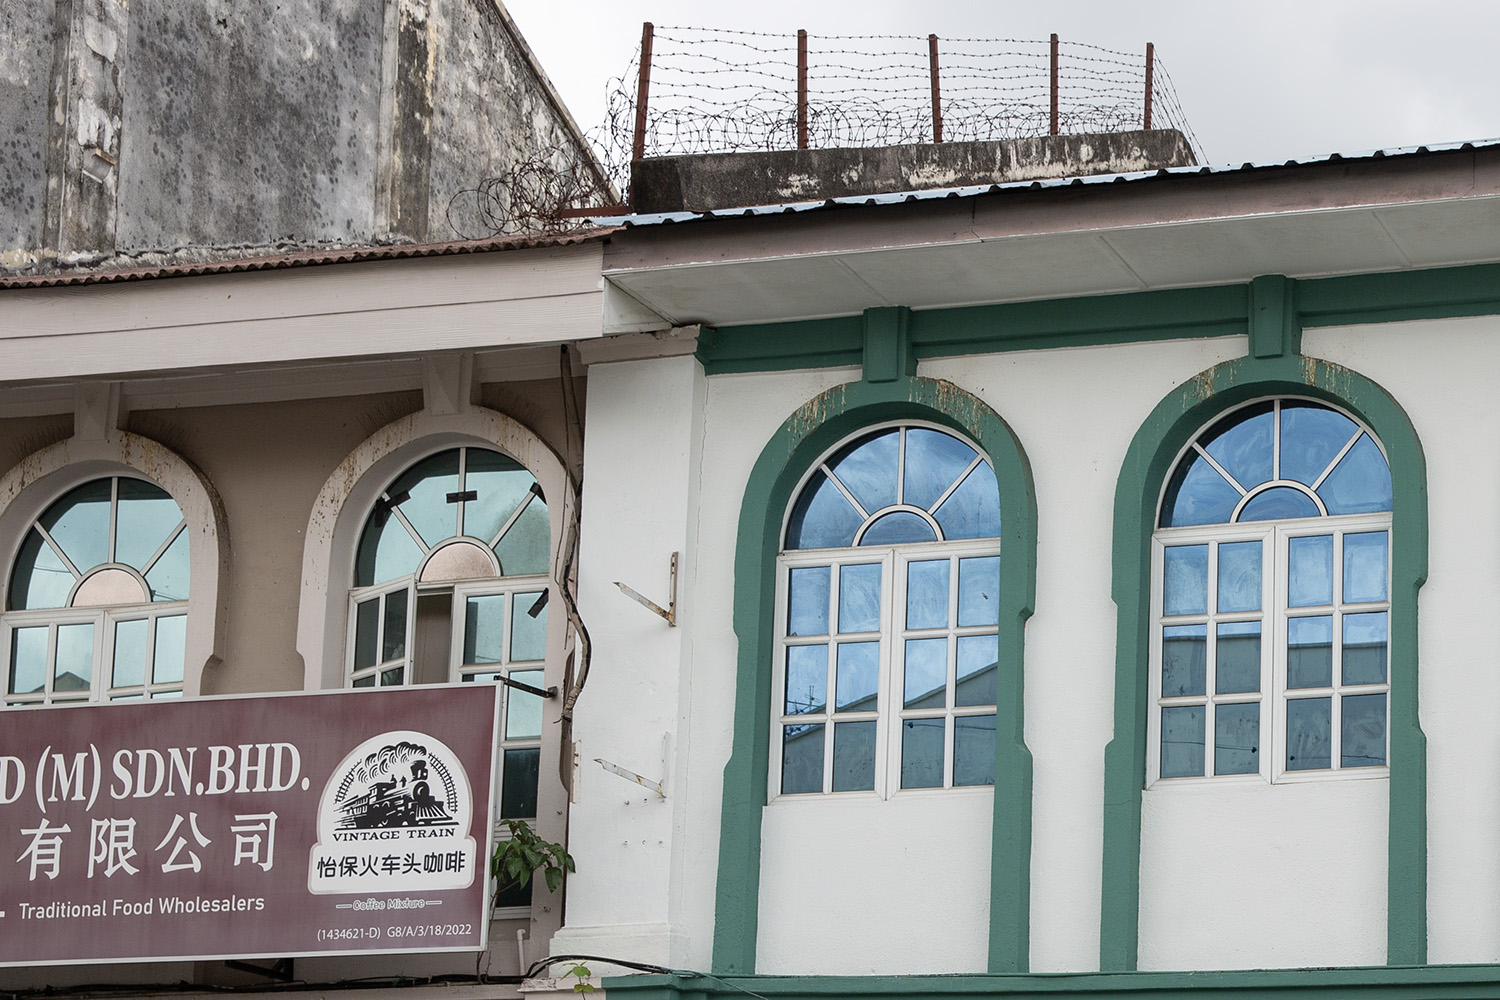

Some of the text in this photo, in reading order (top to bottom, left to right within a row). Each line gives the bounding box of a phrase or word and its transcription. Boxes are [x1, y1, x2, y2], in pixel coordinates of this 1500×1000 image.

[35, 743, 101, 814] (M)
[110, 742, 310, 800] SDN.BHD.
[16, 811, 278, 881] 有限公司
[333, 828, 456, 842] VINTAGE TRAIN
[317, 850, 466, 878] 怡保火车头咖啡
[19, 895, 265, 920] Traditional Food Wholesalers
[352, 897, 425, 911] Coffee Mixture
[317, 924, 472, 942] (1434621-D) G8/A/3/18/2022
